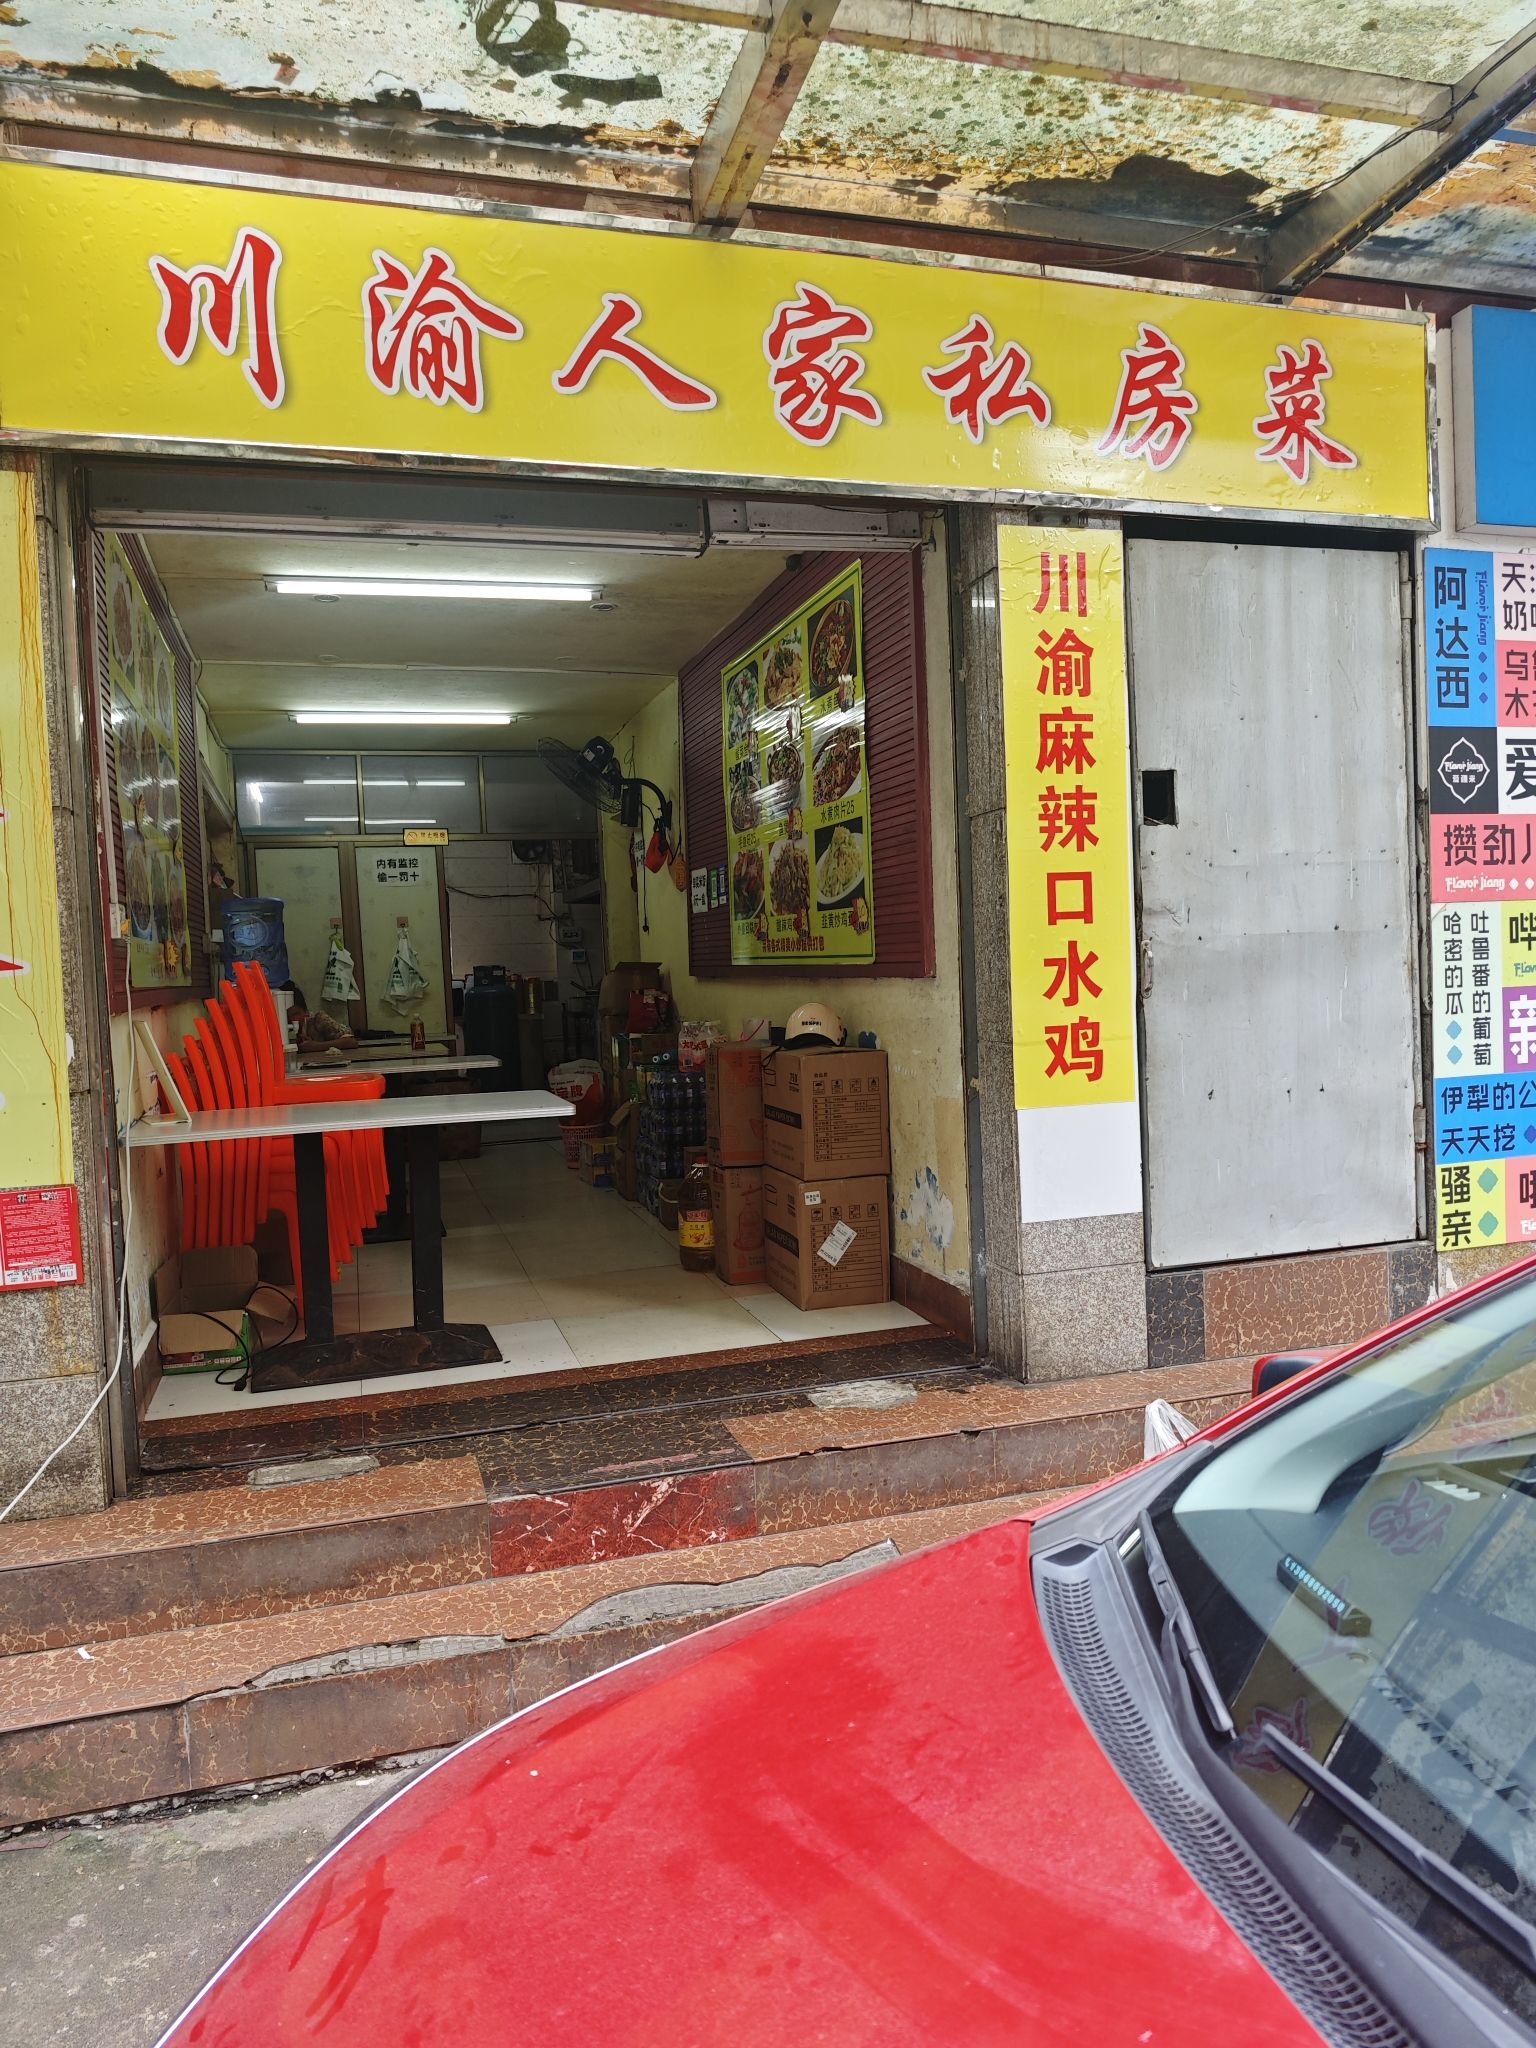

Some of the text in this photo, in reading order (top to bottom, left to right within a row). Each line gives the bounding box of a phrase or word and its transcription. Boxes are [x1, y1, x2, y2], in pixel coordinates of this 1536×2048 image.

[150, 228, 1358, 485] 川渝人家私房菜
[1434, 566, 1470, 709] 阿达西
[1504, 648, 1536, 681] 乌
[1504, 686, 1536, 719] 木
[1033, 551, 1104, 1083] 川渝麻辣口水鸡
[376, 857, 420, 869] 内有监控
[376, 871, 420, 883] 偷一罚十
[1443, 911, 1464, 1015] 哈密的瓜
[1470, 910, 1492, 1066] 吐鲁番的葡萄
[1441, 1123, 1517, 1156] 天天挖
[1440, 1165, 1472, 1248] 骚亲
